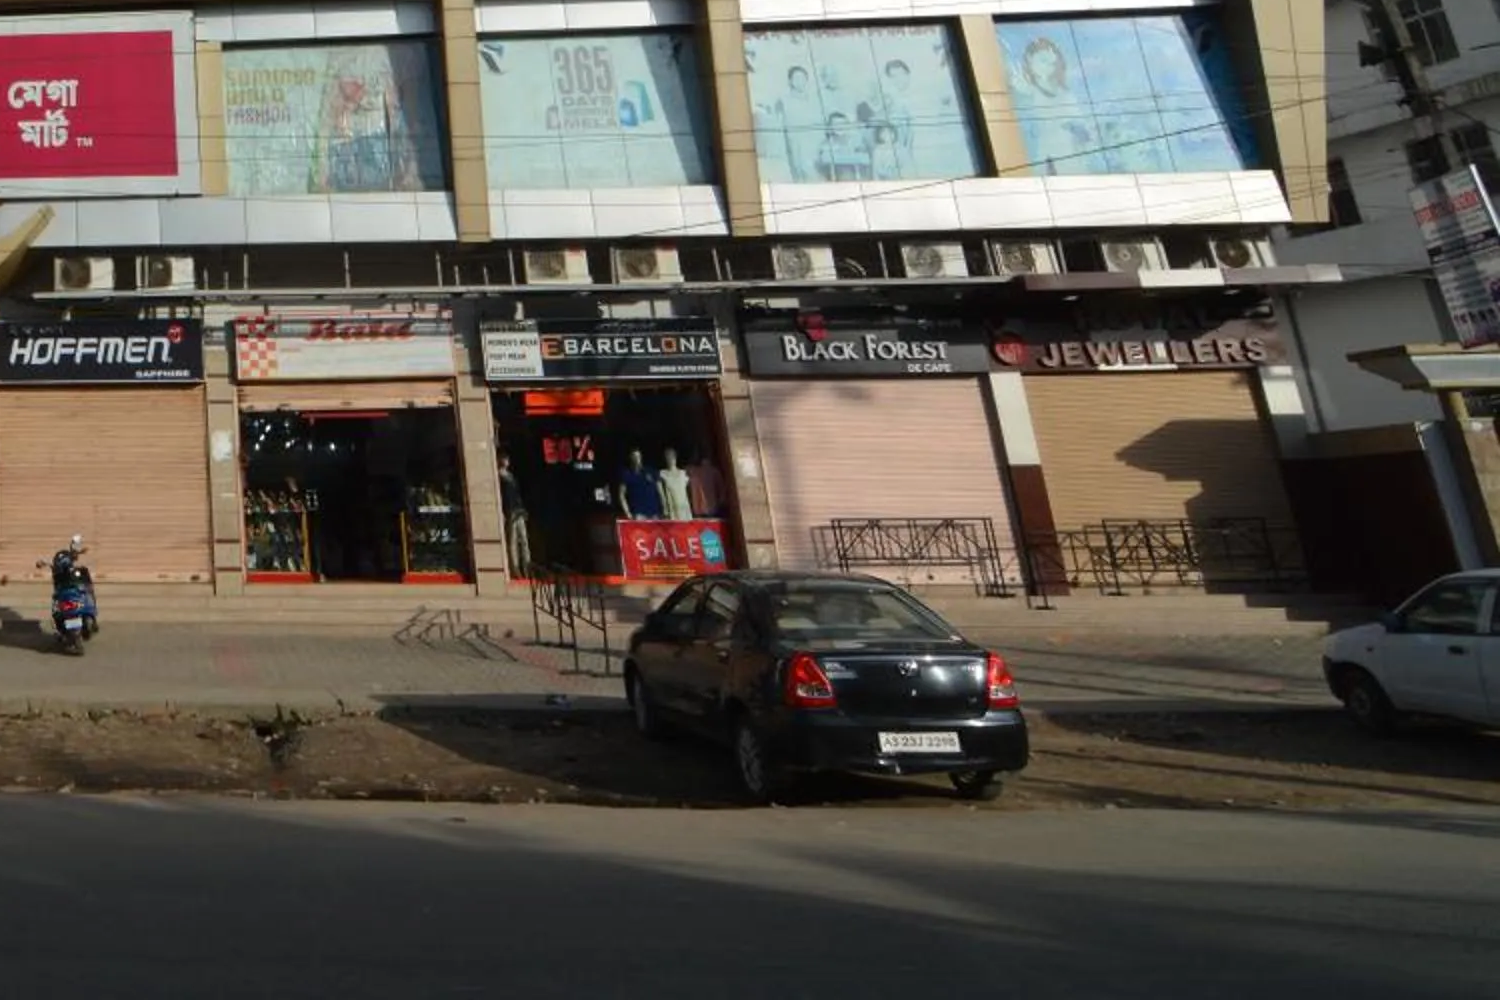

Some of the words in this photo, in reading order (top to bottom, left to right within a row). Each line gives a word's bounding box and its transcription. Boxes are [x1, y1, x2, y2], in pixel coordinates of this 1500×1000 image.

[553, 45, 613, 95] 365
[8, 79, 79, 109] মেগা
[8, 336, 172, 365] HOFFMEN
[564, 336, 714, 355] BARCELONA
[1039, 336, 1268, 368] JEWELLERS
[635, 537, 701, 560] SALE
